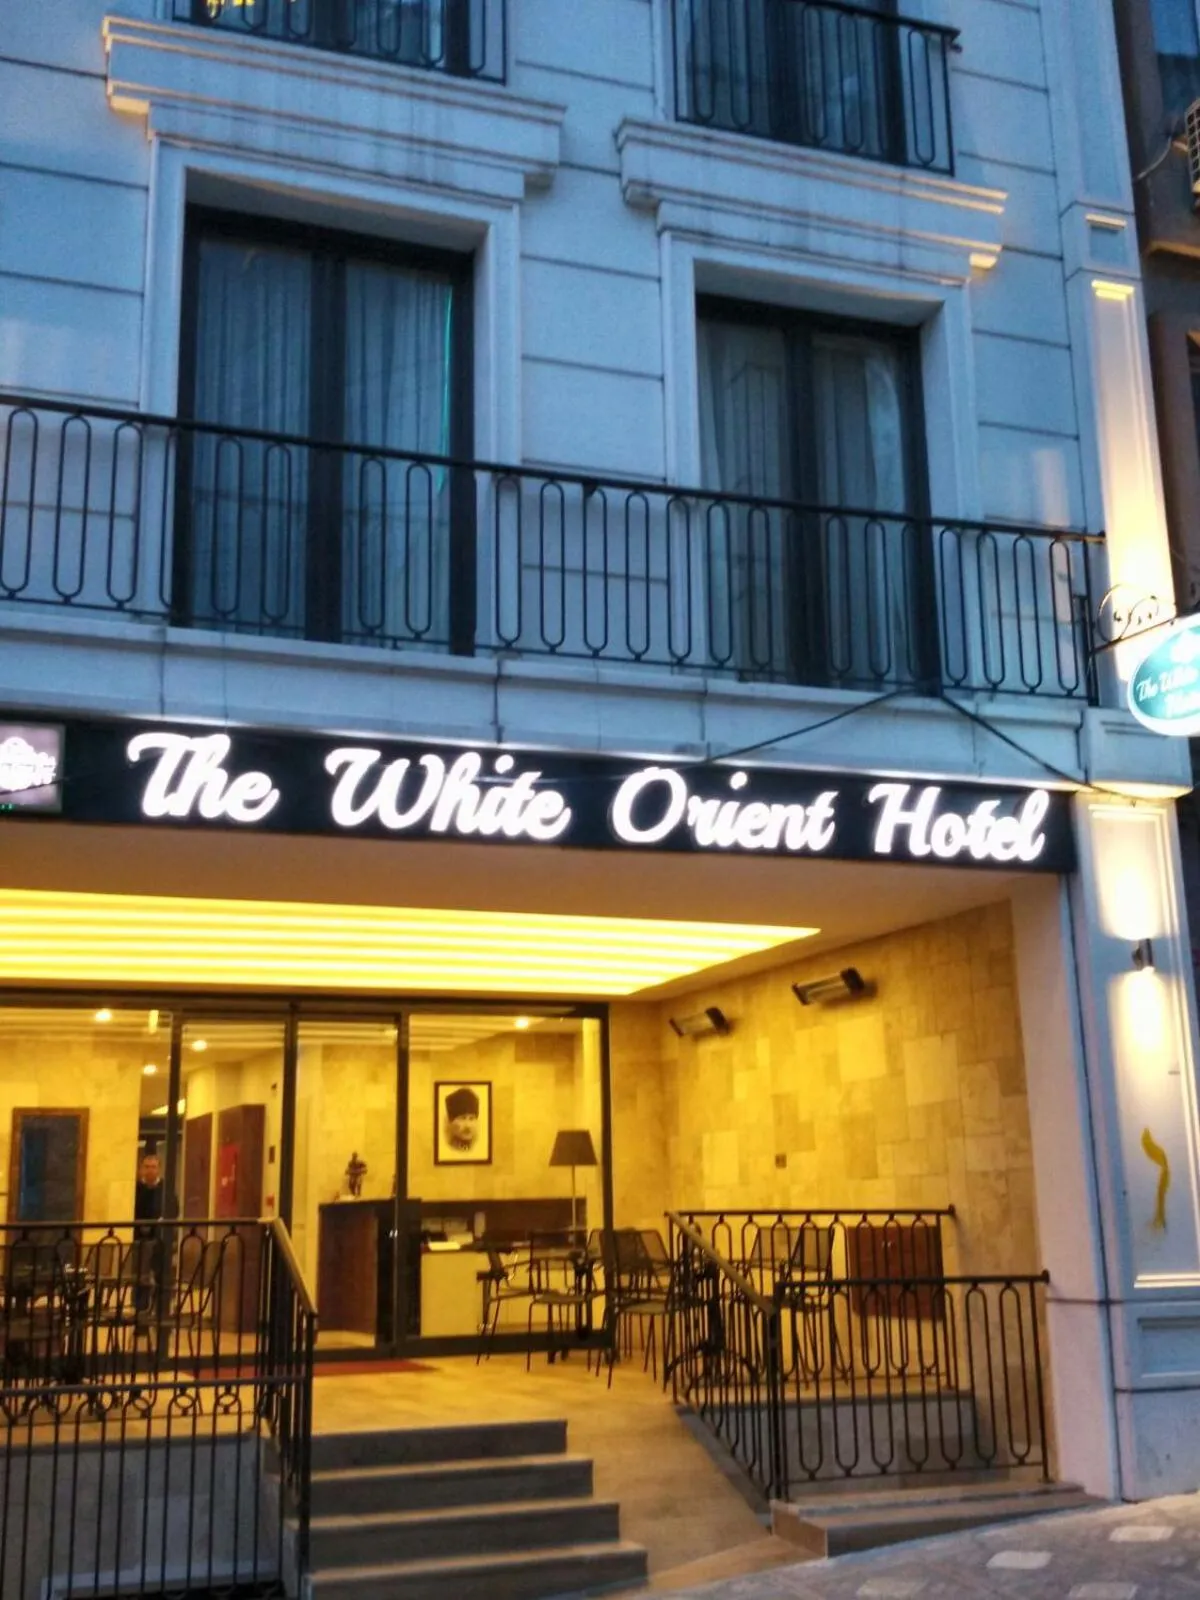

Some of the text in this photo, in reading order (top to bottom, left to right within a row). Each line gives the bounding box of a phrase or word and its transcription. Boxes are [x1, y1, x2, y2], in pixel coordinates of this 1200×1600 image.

[127, 733, 279, 822] The
[325, 748, 572, 840] White
[612, 766, 838, 851] Orient
[868, 783, 1050, 861] Hotel
